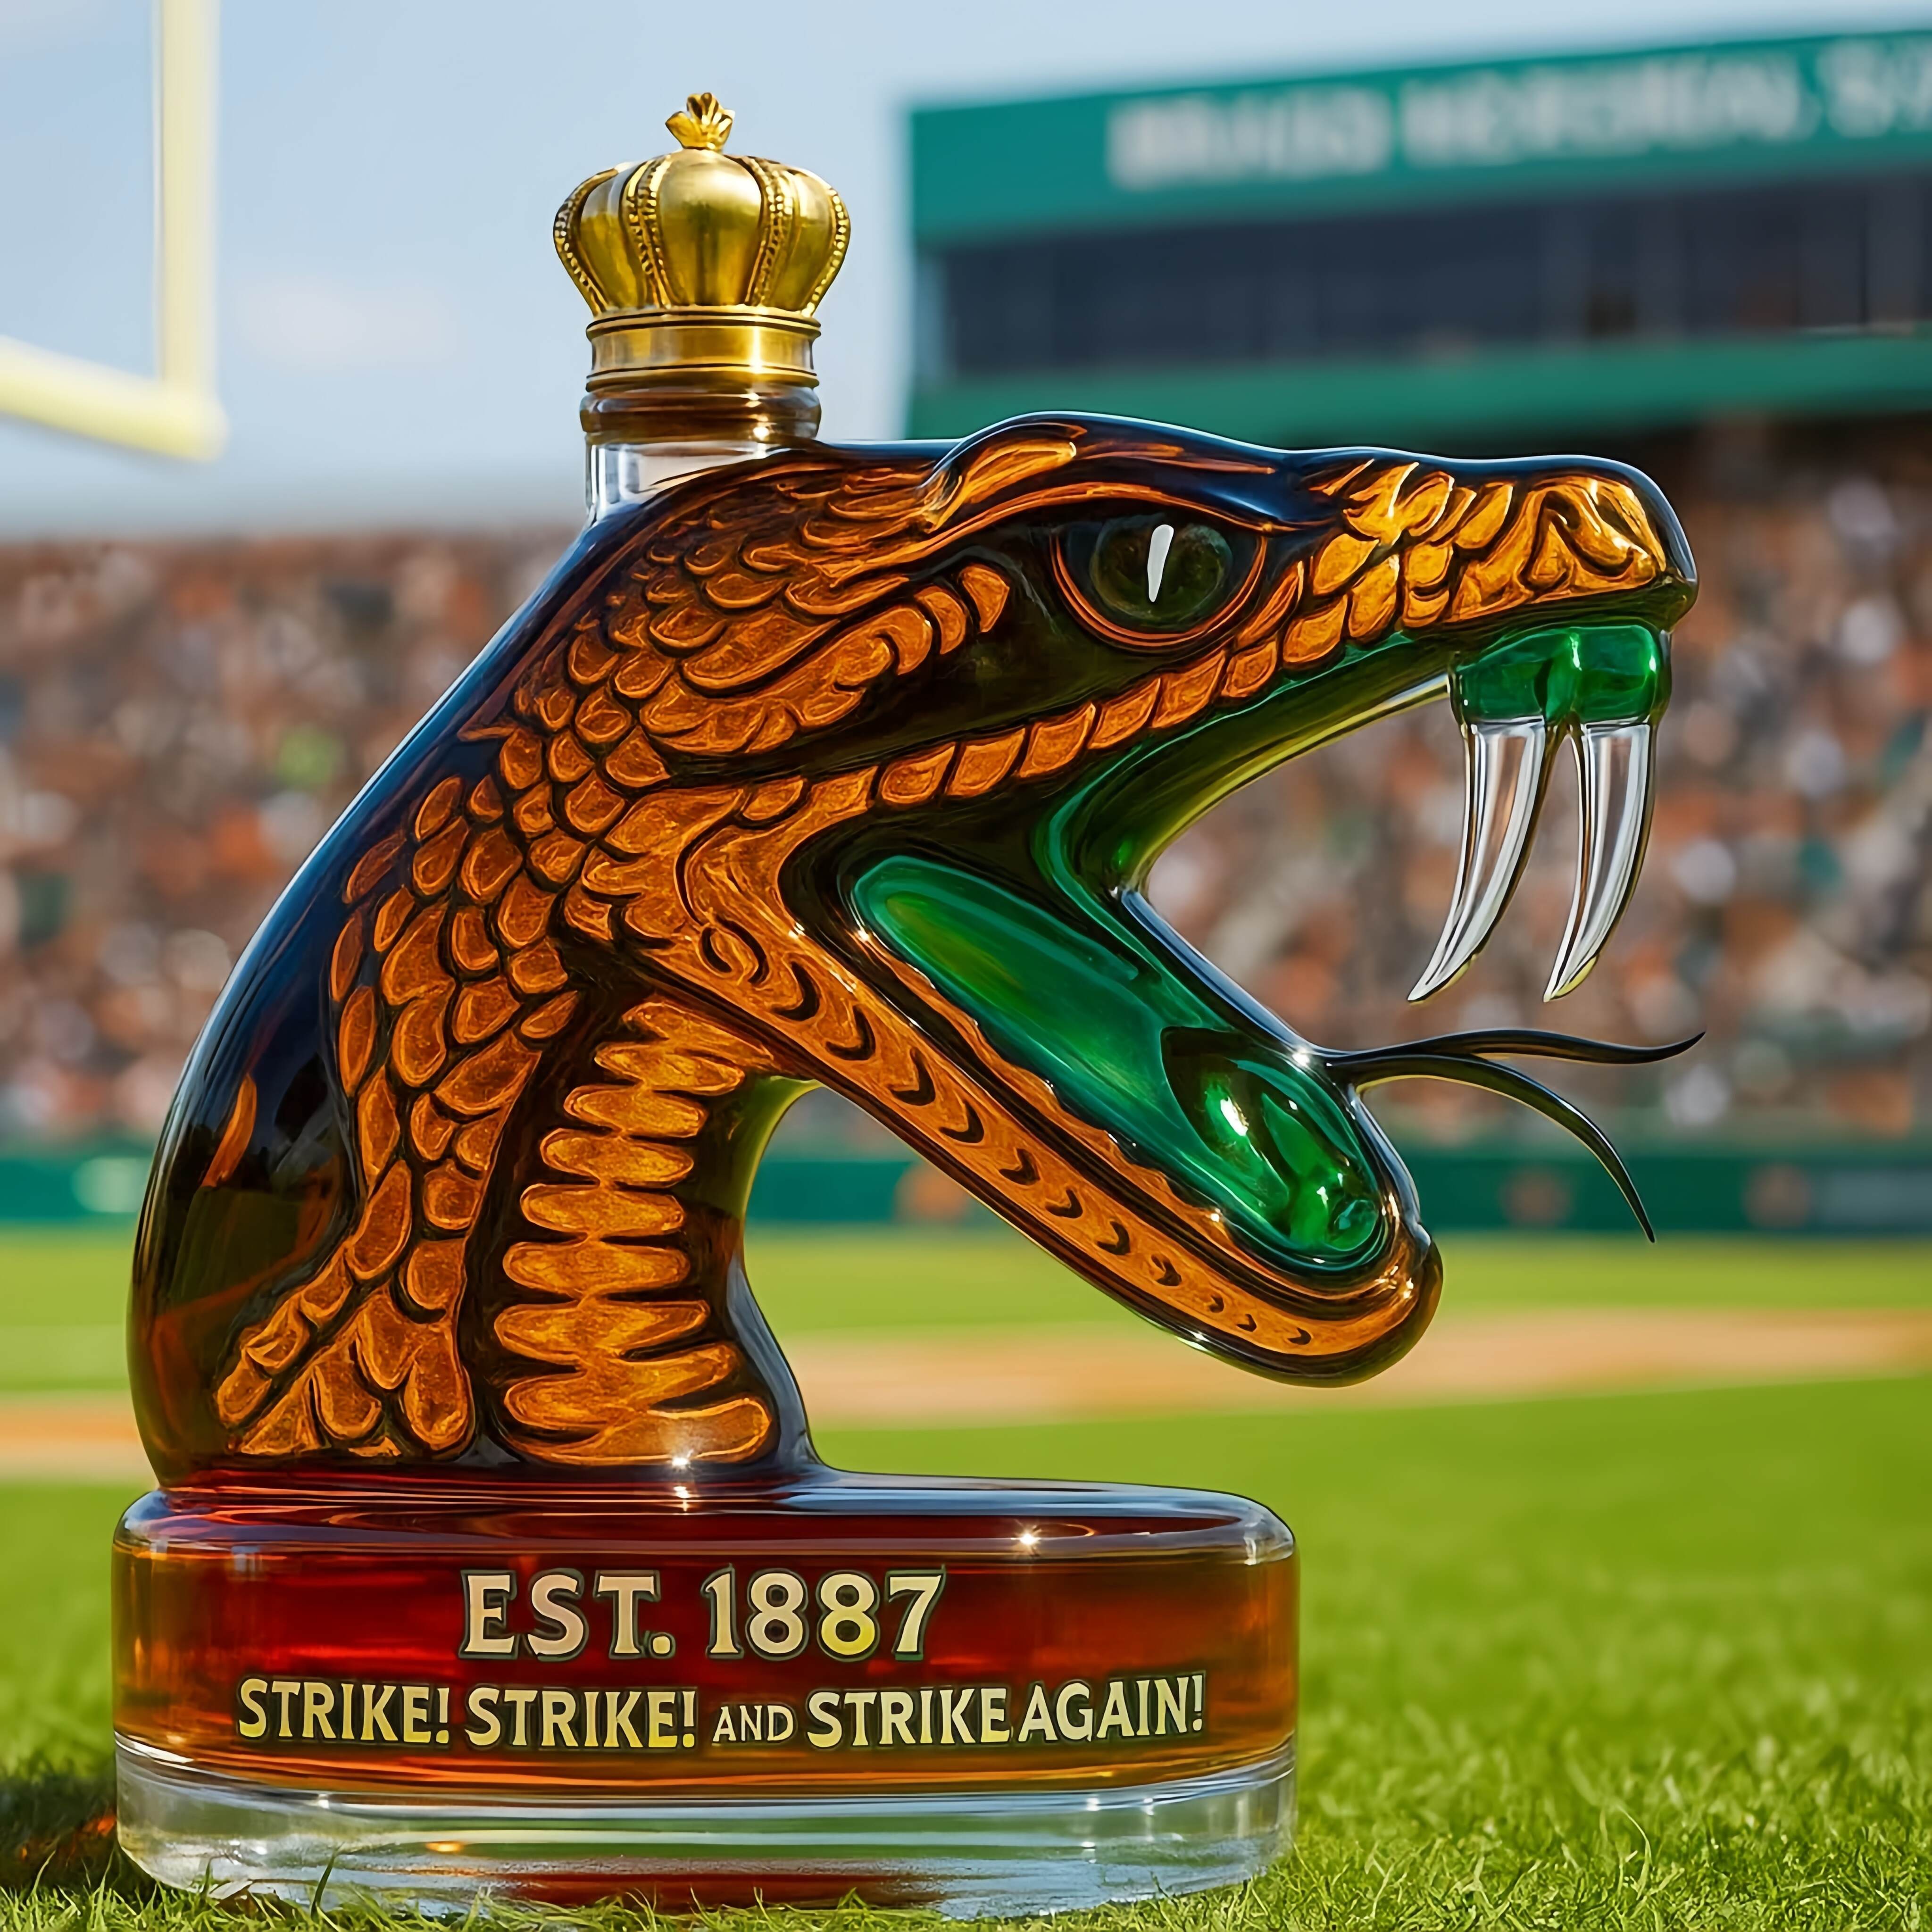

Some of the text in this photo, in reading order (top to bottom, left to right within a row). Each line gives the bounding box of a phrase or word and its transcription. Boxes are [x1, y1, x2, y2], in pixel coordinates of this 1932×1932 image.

[460, 1568, 944, 1660] EST. 1887
[238, 1675, 1204, 1749] STRIKE! STRIKE! AND STRIKE AGAIN!
